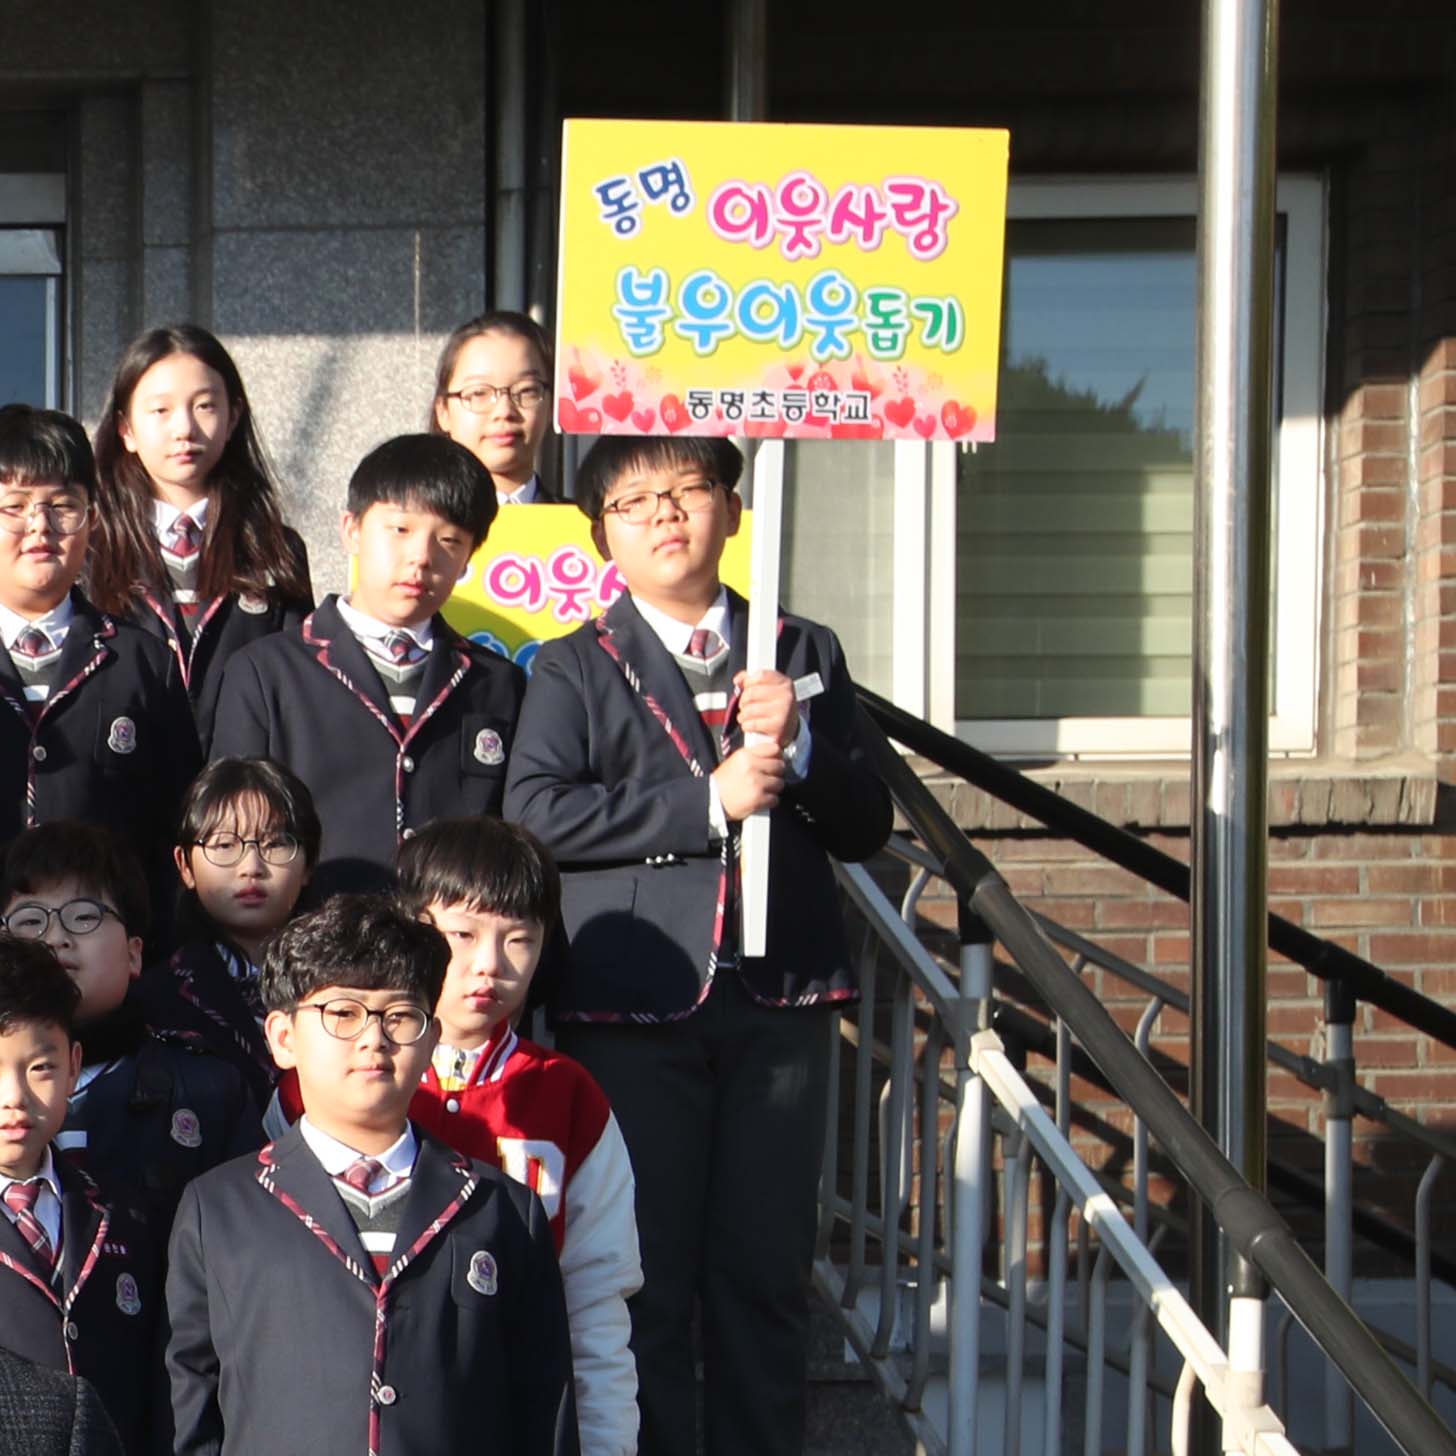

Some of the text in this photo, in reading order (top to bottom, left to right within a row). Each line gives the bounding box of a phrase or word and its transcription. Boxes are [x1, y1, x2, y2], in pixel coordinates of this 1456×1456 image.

[593, 158, 959, 261] 동명 이웃사랑
[612, 265, 966, 361] 불우이웃돕기
[686, 389, 872, 423] 동명초등학교
[486, 547, 629, 624] 이웃
